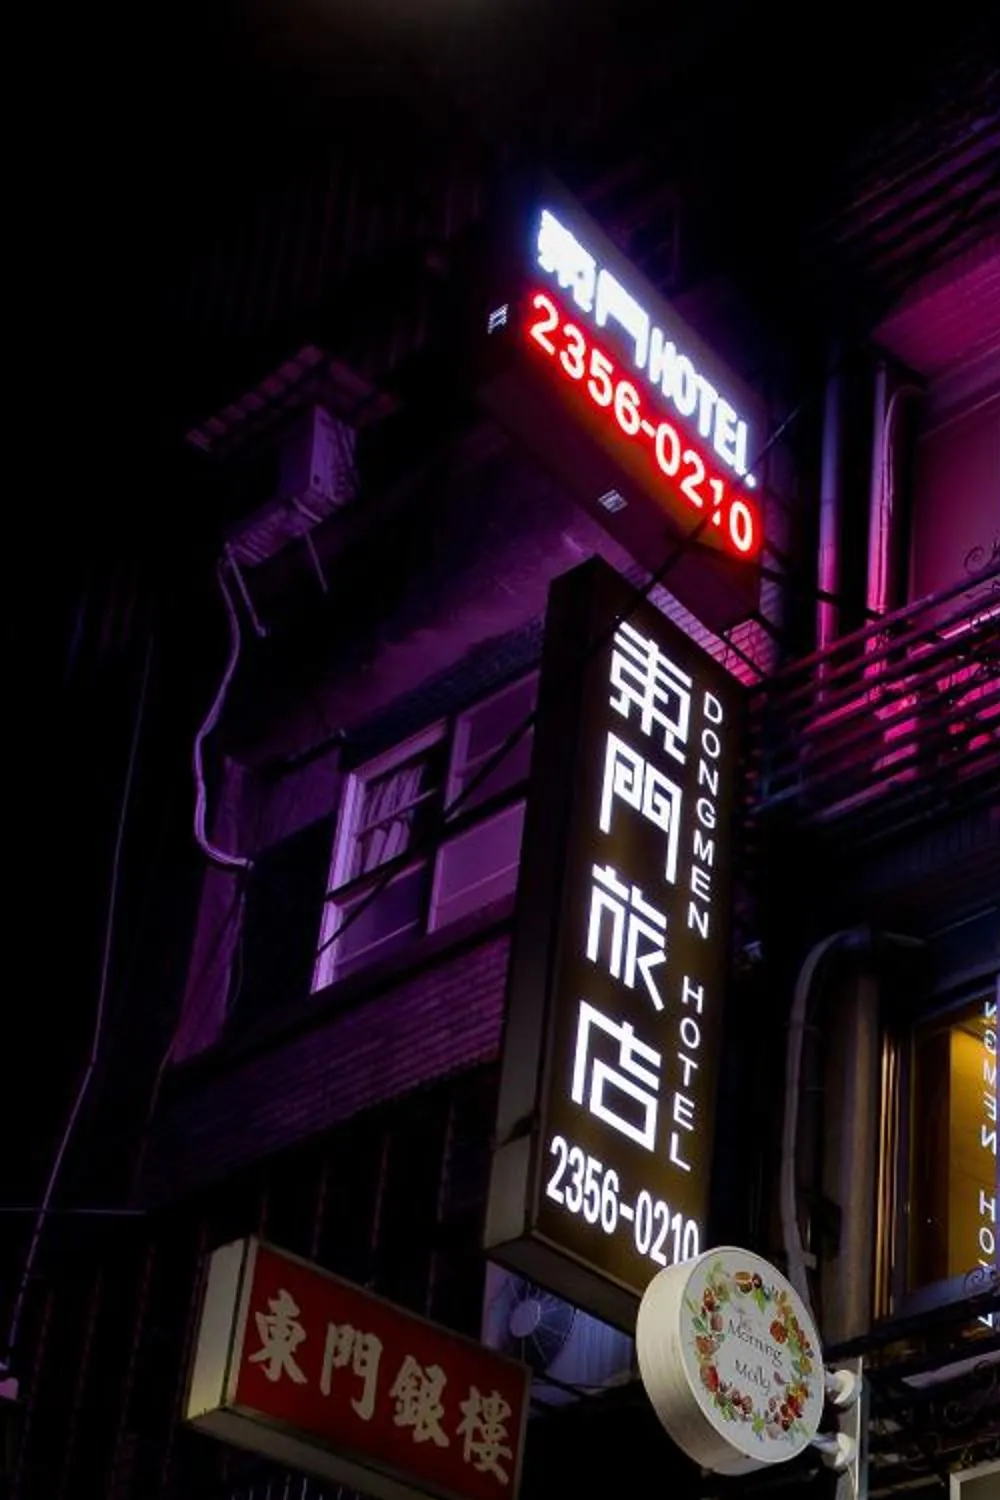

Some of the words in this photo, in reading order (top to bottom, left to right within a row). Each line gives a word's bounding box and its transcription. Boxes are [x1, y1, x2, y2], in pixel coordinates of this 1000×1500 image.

[529, 293, 754, 553] 2356-0210
[649, 326, 756, 488] HOTEL
[570, 620, 693, 1152] 東門旅店
[687, 691, 723, 940] DONGMEN
[669, 975, 704, 1172] HOTEL
[546, 1135, 699, 1267] 2356-0210
[248, 1288, 513, 1486] 東門銀樓
